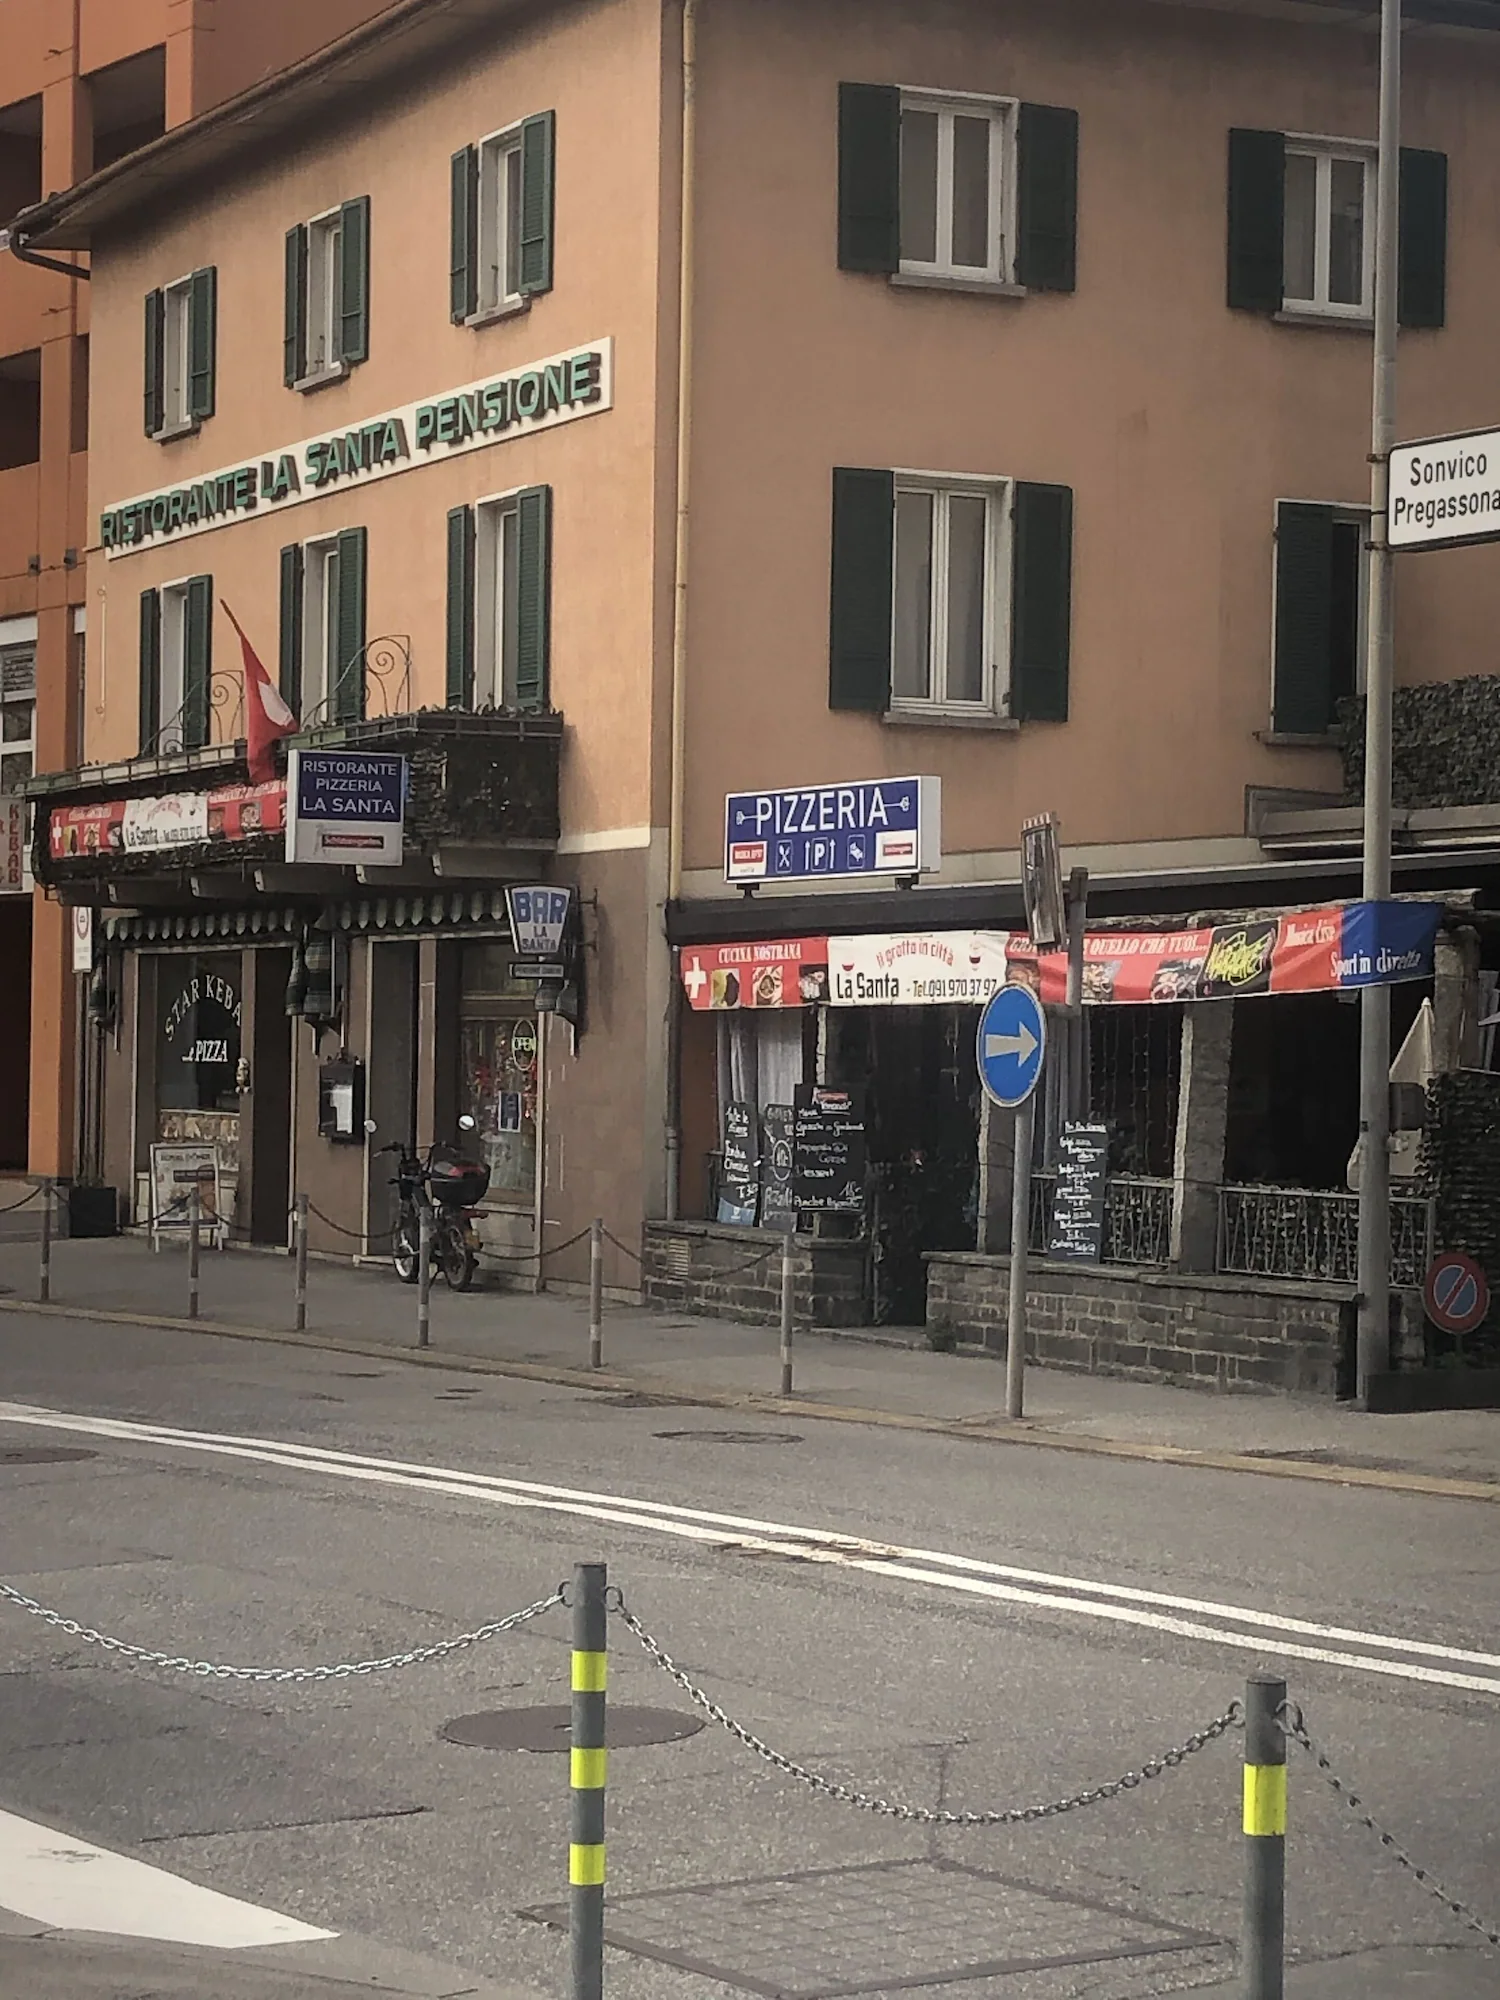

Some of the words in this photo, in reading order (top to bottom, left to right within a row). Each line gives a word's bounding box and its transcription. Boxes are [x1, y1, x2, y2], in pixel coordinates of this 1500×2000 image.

[101, 467, 257, 549] RISTORANTE
[261, 454, 300, 499] LA
[305, 417, 409, 486] SANTA
[416, 351, 602, 451] PENSIONE
[1410, 450, 1487, 486] Sonvico
[1394, 489, 1500, 529] Pregassona
[302, 760, 397, 776] RISTORANTE
[316, 778, 383, 792] PIZZERIA
[302, 796, 327, 812] LA
[332, 797, 395, 814] SANTA
[756, 786, 889, 836] PIZZERIA
[8, 803, 19, 884] KEBAB
[514, 892, 567, 924] BAR
[521, 939, 557, 951] SANTA
[533, 926, 548, 938] LA
[1090, 937, 1139, 957] QUELLO
[1139, 936, 1167, 955] CHE
[718, 946, 752, 964] CUCINA
[753, 942, 802, 961] NOSTRANA
[1330, 950, 1357, 982] Sport
[1359, 949, 1371, 974] in
[1376, 947, 1422, 974] diretta
[836, 973, 853, 999] La
[856, 972, 900, 998] Santa
[948, 979, 968, 997] 970
[969, 978, 982, 997] 37
[165, 978, 200, 1042] STAR
